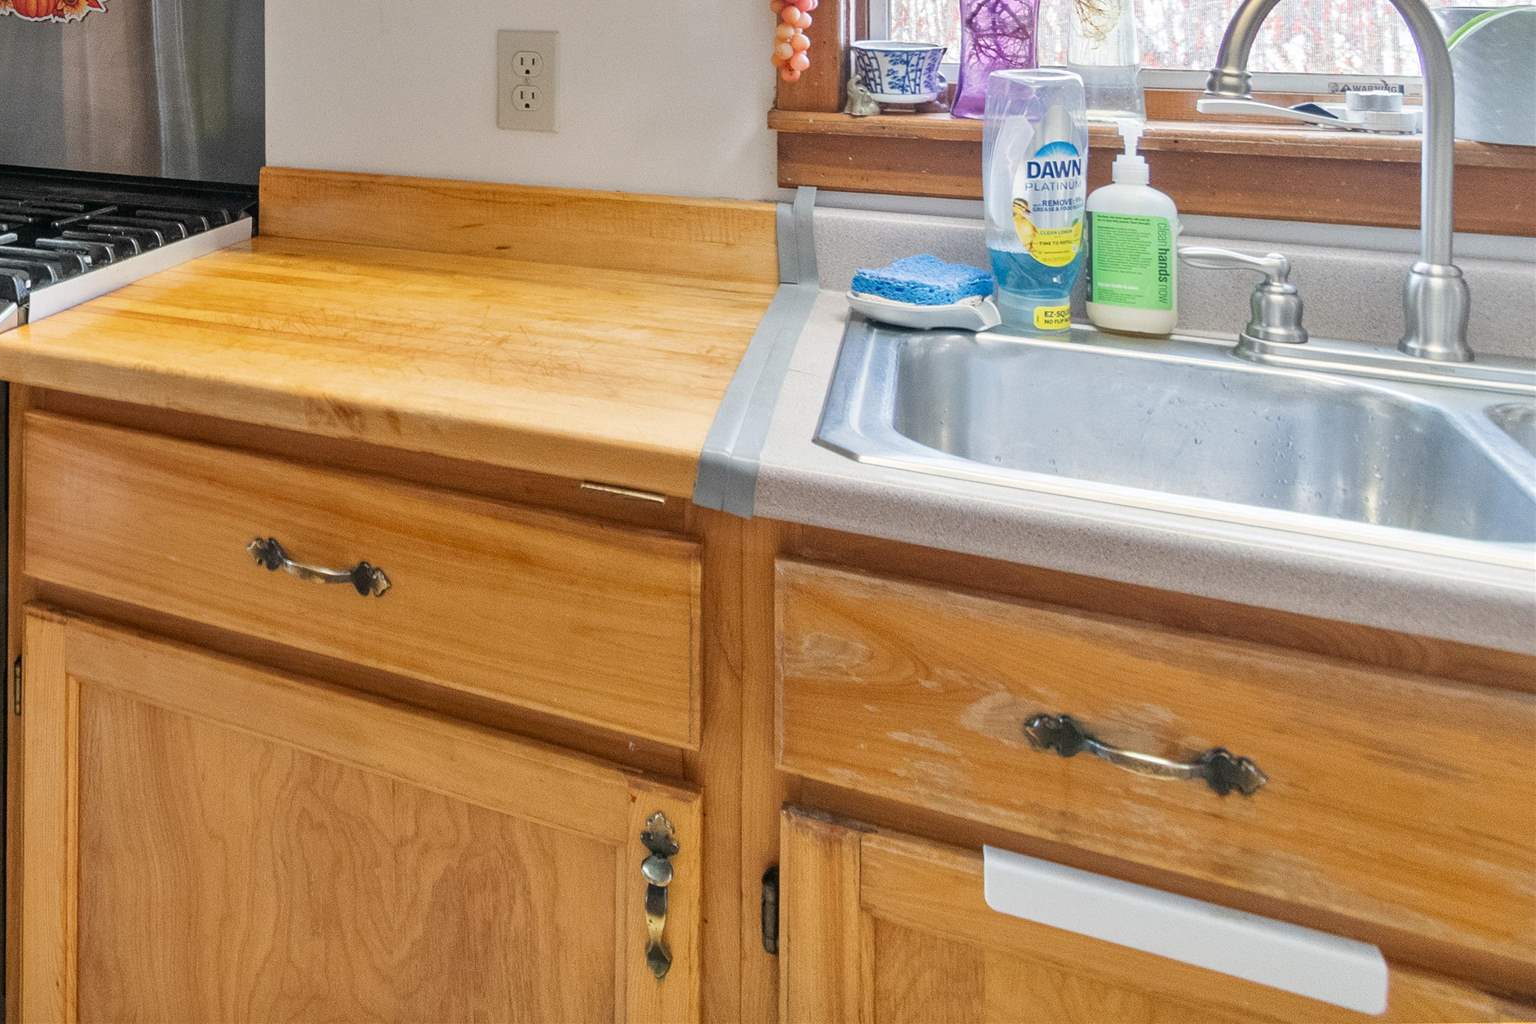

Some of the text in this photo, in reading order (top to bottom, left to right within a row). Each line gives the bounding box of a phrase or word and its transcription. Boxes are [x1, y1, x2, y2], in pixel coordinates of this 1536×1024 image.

[1026, 159, 1081, 179] DAWN
[1024, 180, 1081, 192] PLATINUM
[1042, 198, 1073, 207] REMOVE
[1157, 248, 1171, 283] hands
[1158, 284, 1169, 305] now
